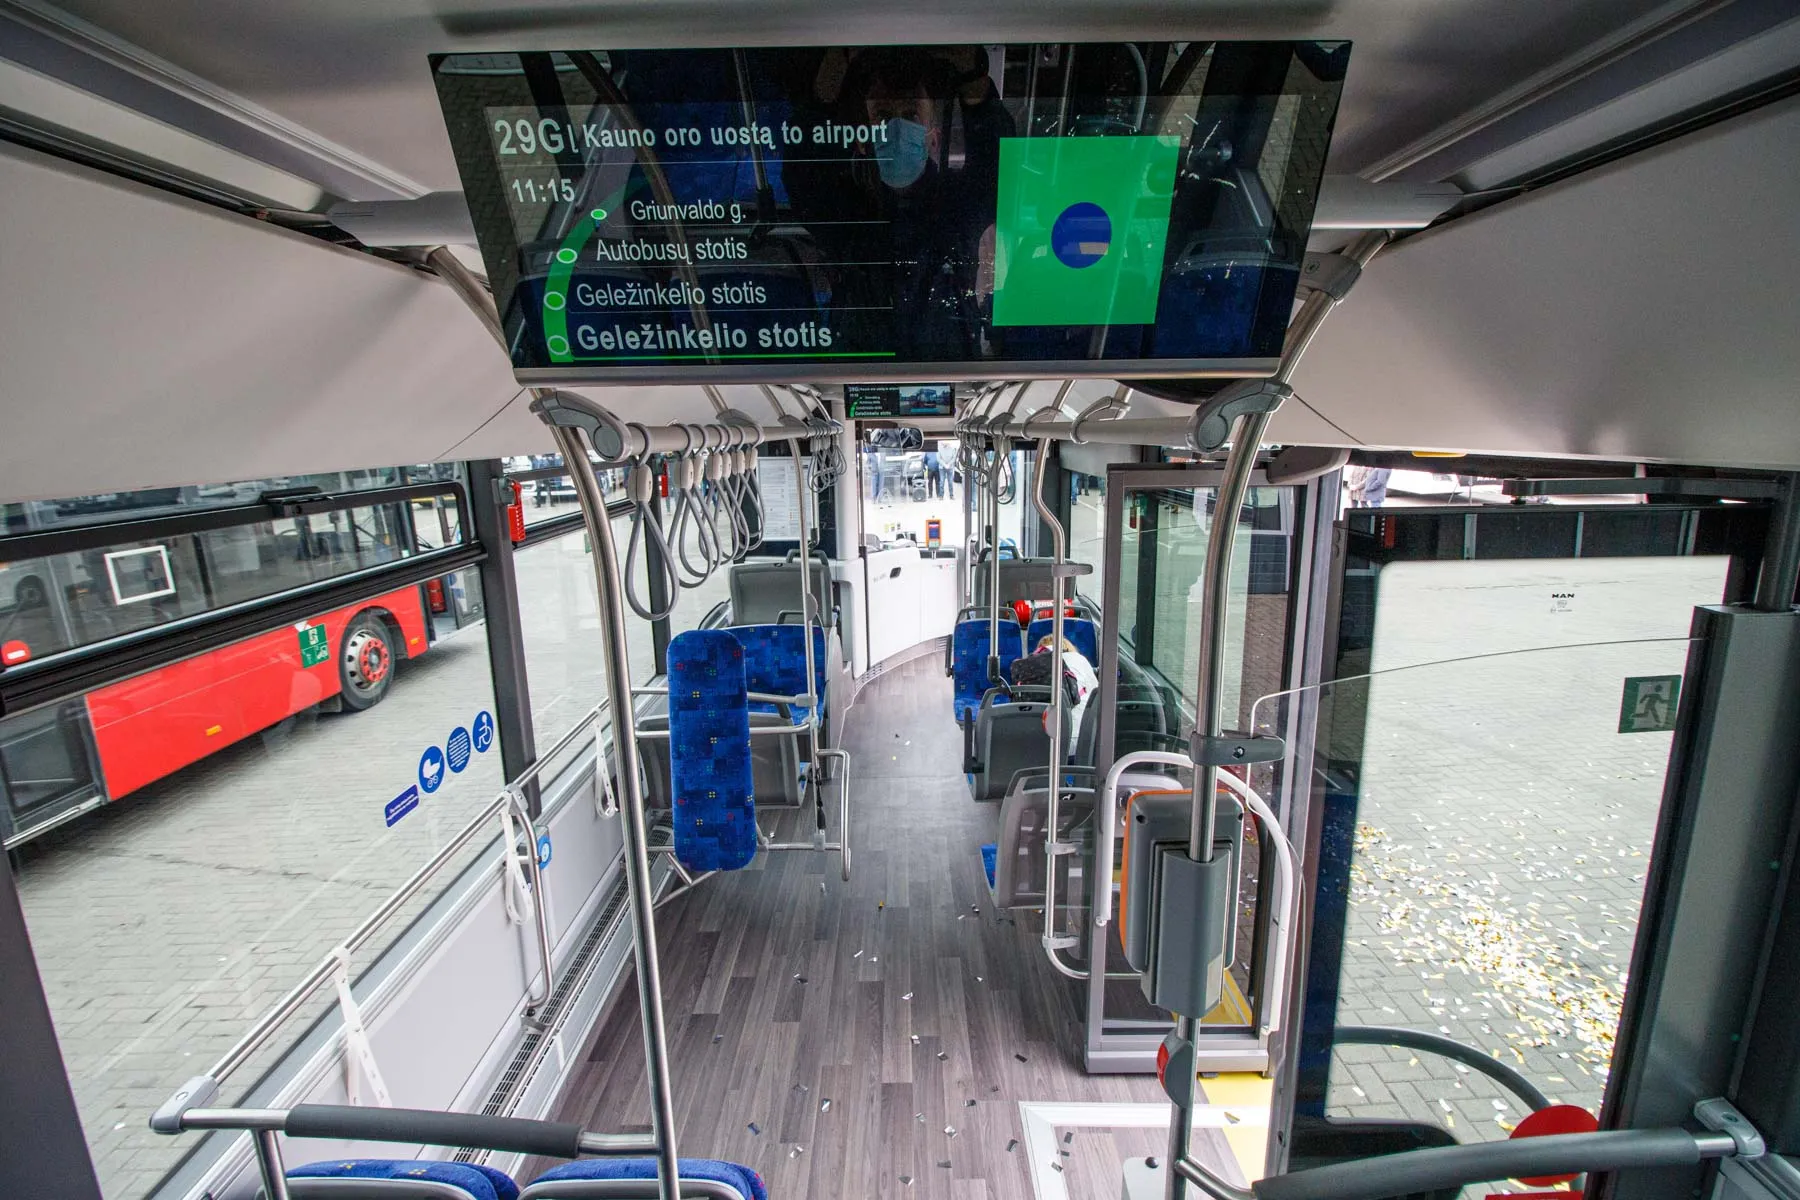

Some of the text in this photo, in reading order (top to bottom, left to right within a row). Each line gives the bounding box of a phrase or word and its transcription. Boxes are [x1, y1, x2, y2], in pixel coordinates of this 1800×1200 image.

[495, 118, 565, 154] 29G
[583, 124, 655, 147] Kauno
[665, 127, 701, 146] oro
[711, 121, 776, 150] uostą
[781, 120, 802, 144] to
[812, 119, 888, 149] airport
[512, 178, 575, 203] 11:15
[631, 199, 747, 224] Griunvaldo g.
[596, 237, 748, 265] Autobusų stotis
[576, 280, 767, 306] Geležinkelio stotis
[577, 321, 832, 350] Geležinkelio stotis
